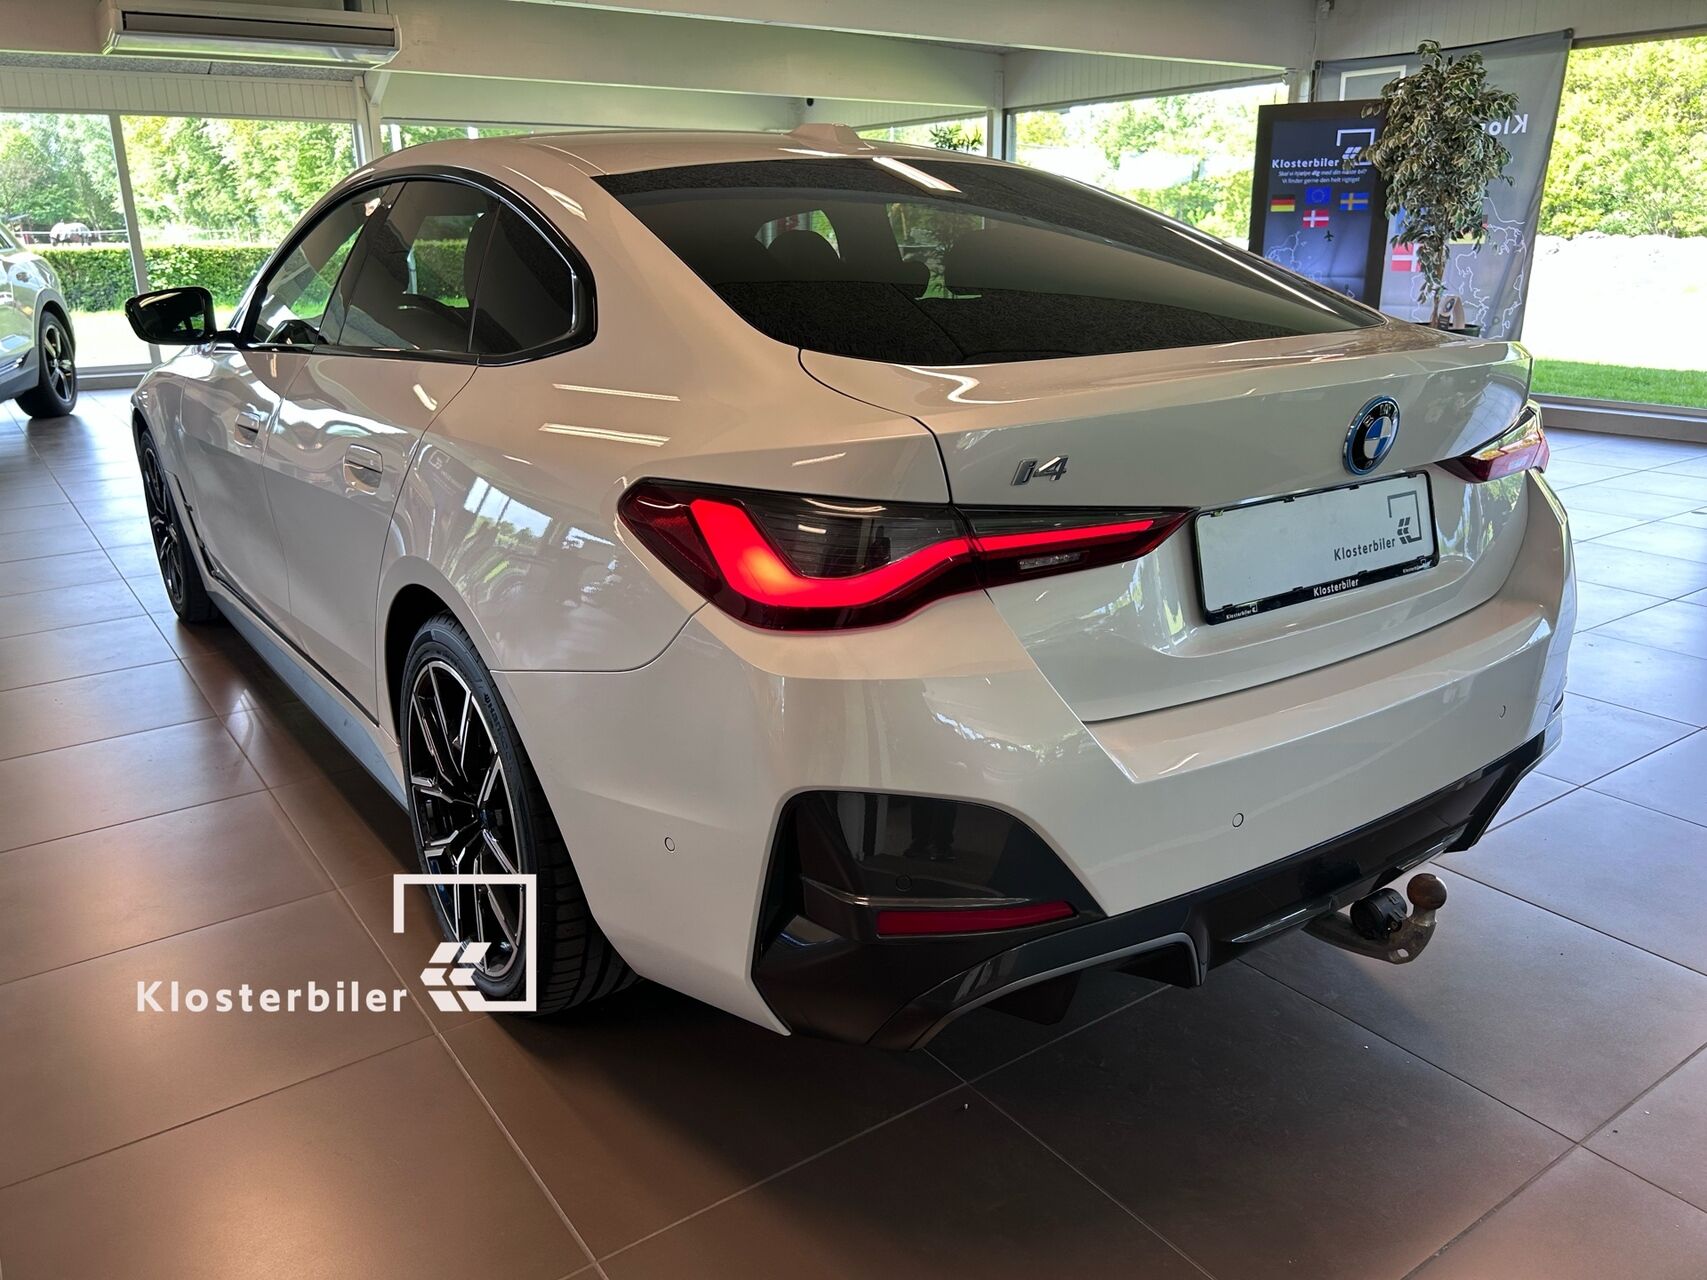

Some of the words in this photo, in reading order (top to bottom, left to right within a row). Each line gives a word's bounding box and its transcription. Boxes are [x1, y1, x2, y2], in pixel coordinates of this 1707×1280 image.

[1271, 158, 1340, 169] Klosterbiler
[1011, 455, 1069, 486] i4
[1333, 537, 1396, 561] Klosterbiler
[1313, 578, 1360, 597] Klosterbiler
